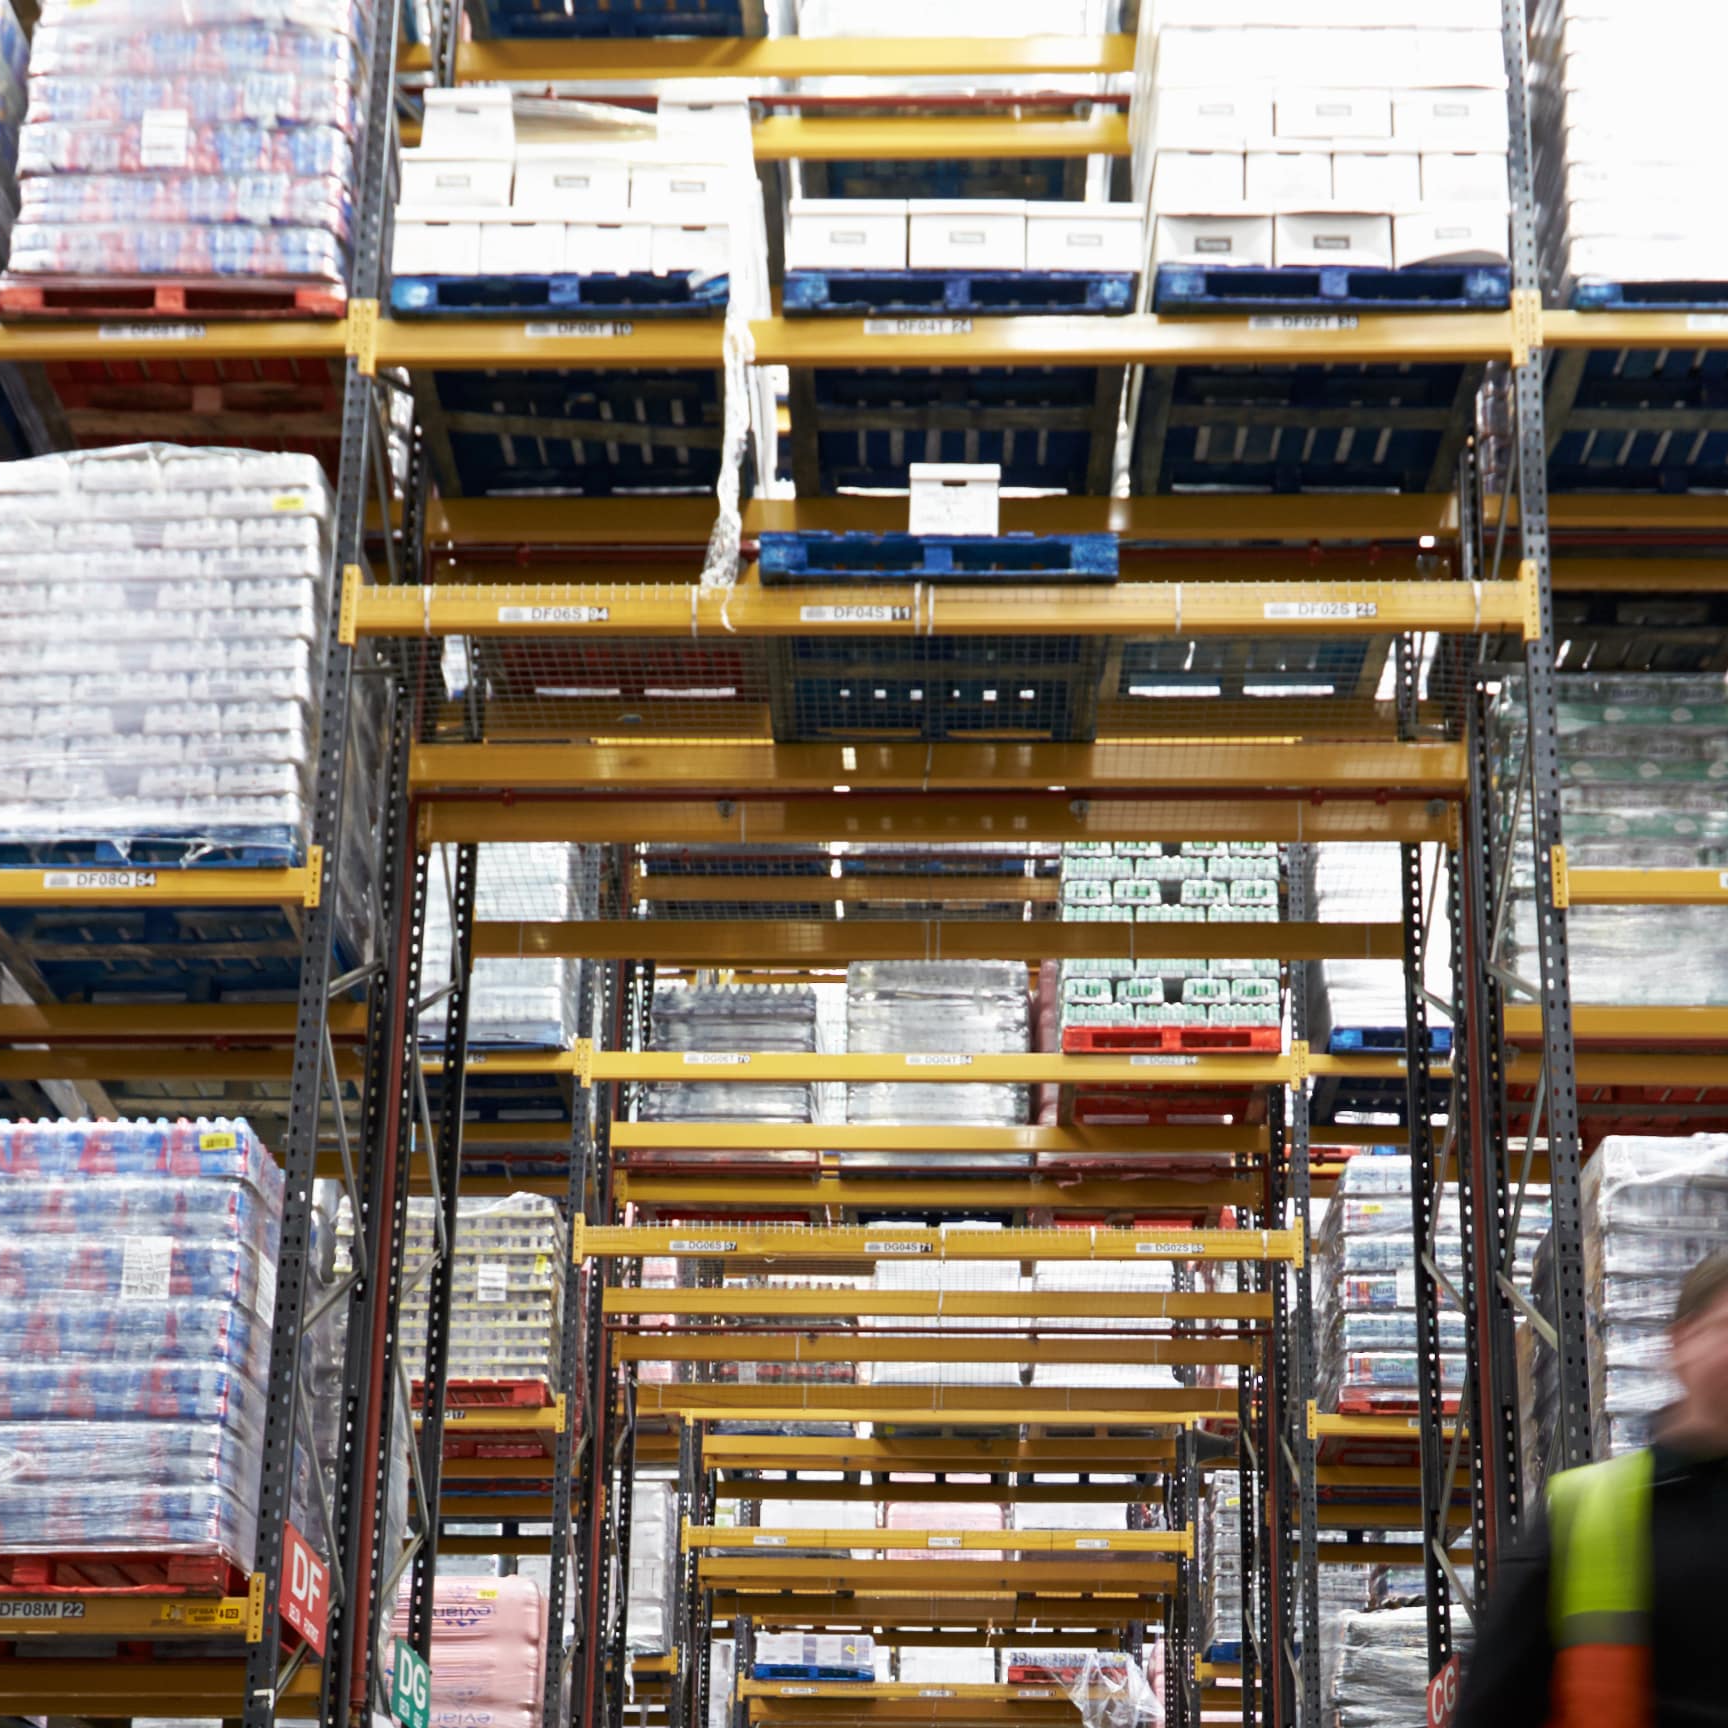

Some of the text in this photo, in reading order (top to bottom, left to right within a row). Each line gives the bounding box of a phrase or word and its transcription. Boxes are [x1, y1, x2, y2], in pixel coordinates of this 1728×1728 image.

[833, 607, 884, 618] DF04S
[1298, 604, 1349, 615] DF02S
[77, 873, 156, 886] DF08Q 54
[292, 1541, 323, 1613] DF
[62, 1602, 84, 1617] 22
[400, 1648, 427, 1711] DG
[1432, 1665, 1456, 1725] CG
